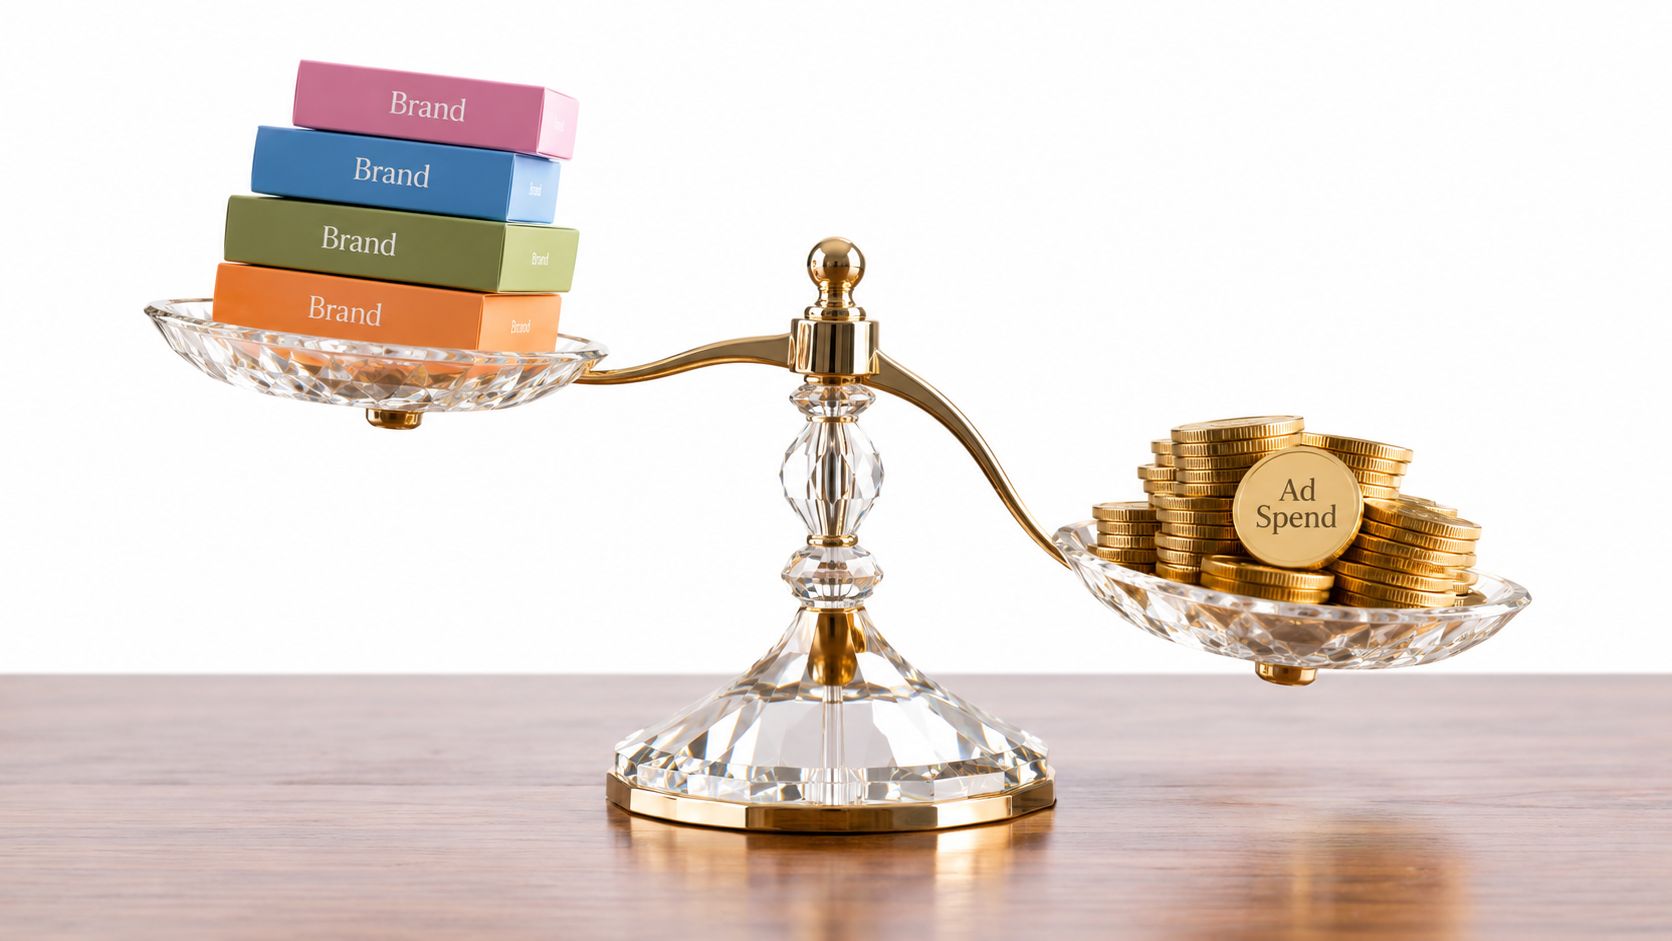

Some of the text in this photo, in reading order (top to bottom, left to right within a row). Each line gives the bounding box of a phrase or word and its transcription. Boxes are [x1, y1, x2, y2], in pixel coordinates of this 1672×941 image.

[390, 90, 466, 122] Brand
[354, 157, 431, 189] Brand
[321, 225, 397, 257] Brand
[308, 295, 382, 327] Brand
[1279, 477, 1316, 502] Ad
[1256, 504, 1337, 535] Spend
